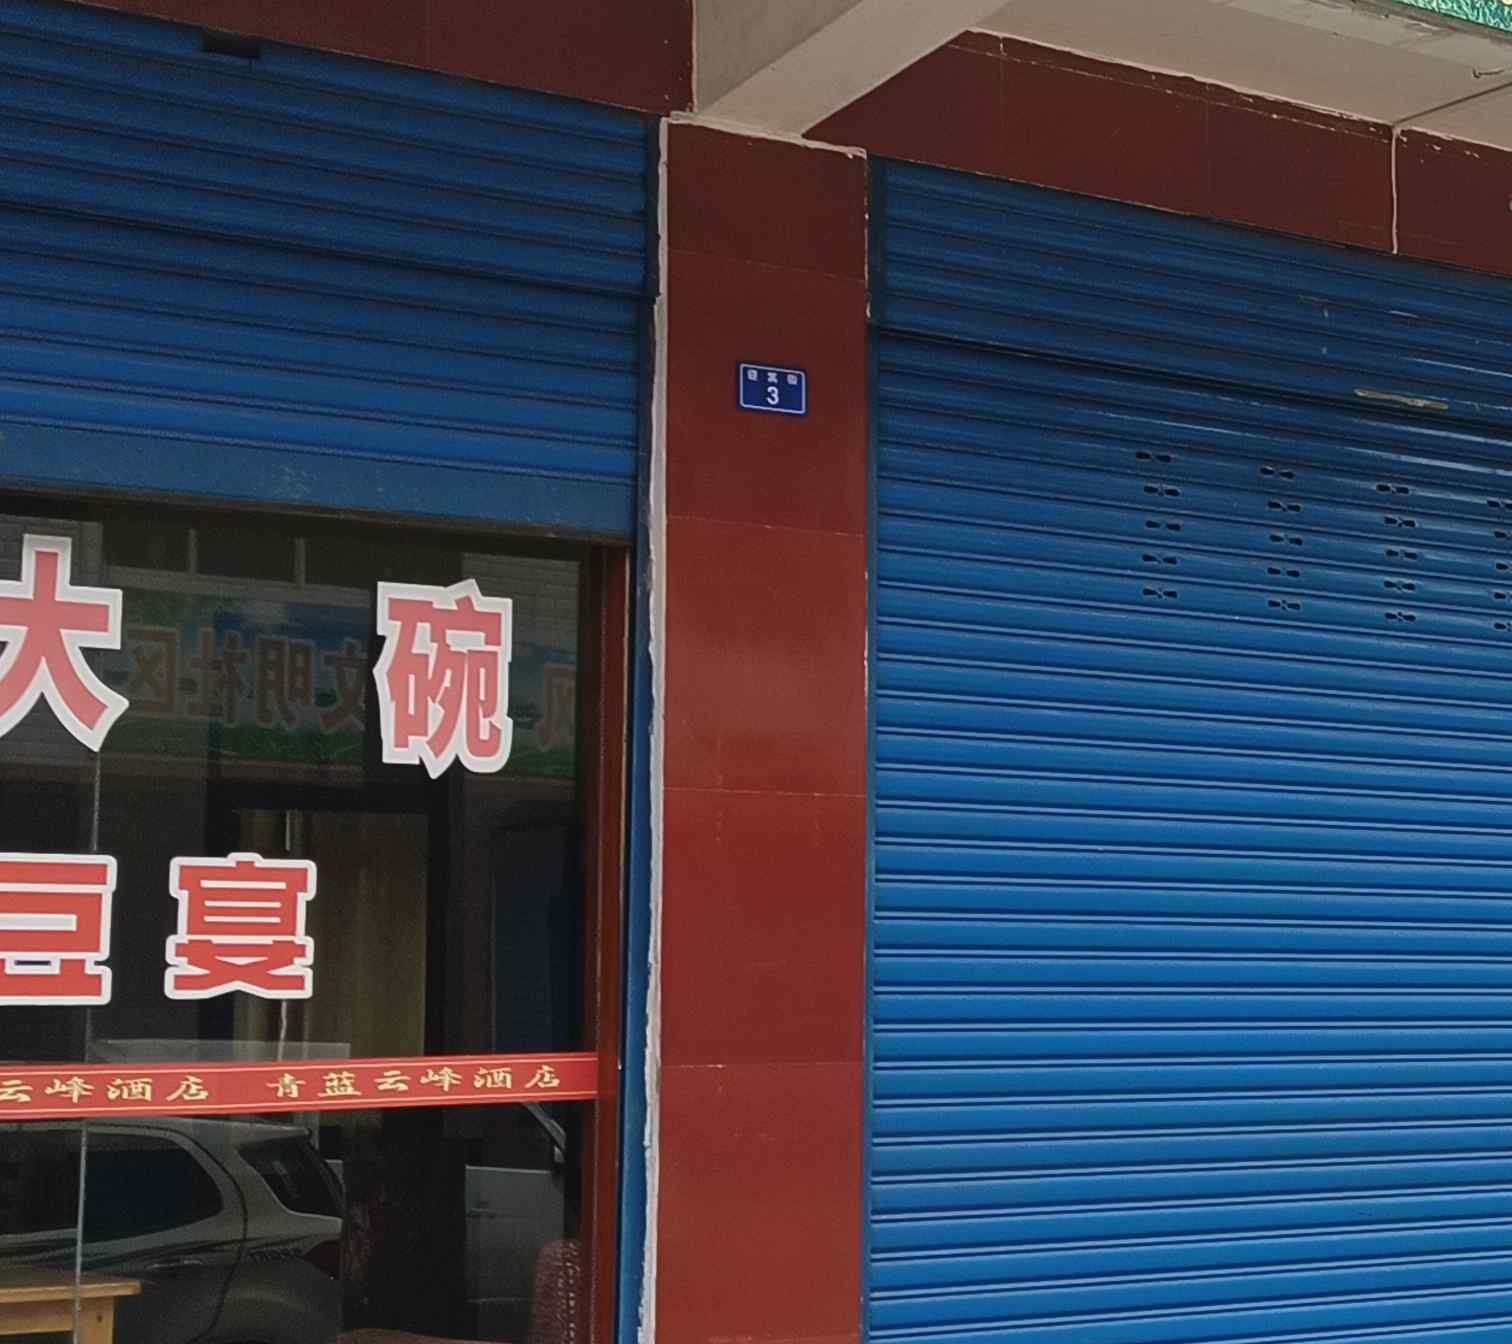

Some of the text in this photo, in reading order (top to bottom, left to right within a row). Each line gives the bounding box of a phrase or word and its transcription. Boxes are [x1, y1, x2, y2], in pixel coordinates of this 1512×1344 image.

[767, 386, 780, 405] 3
[0, 1065, 562, 1103] 云峰酒店 青蓝云峰酒店
